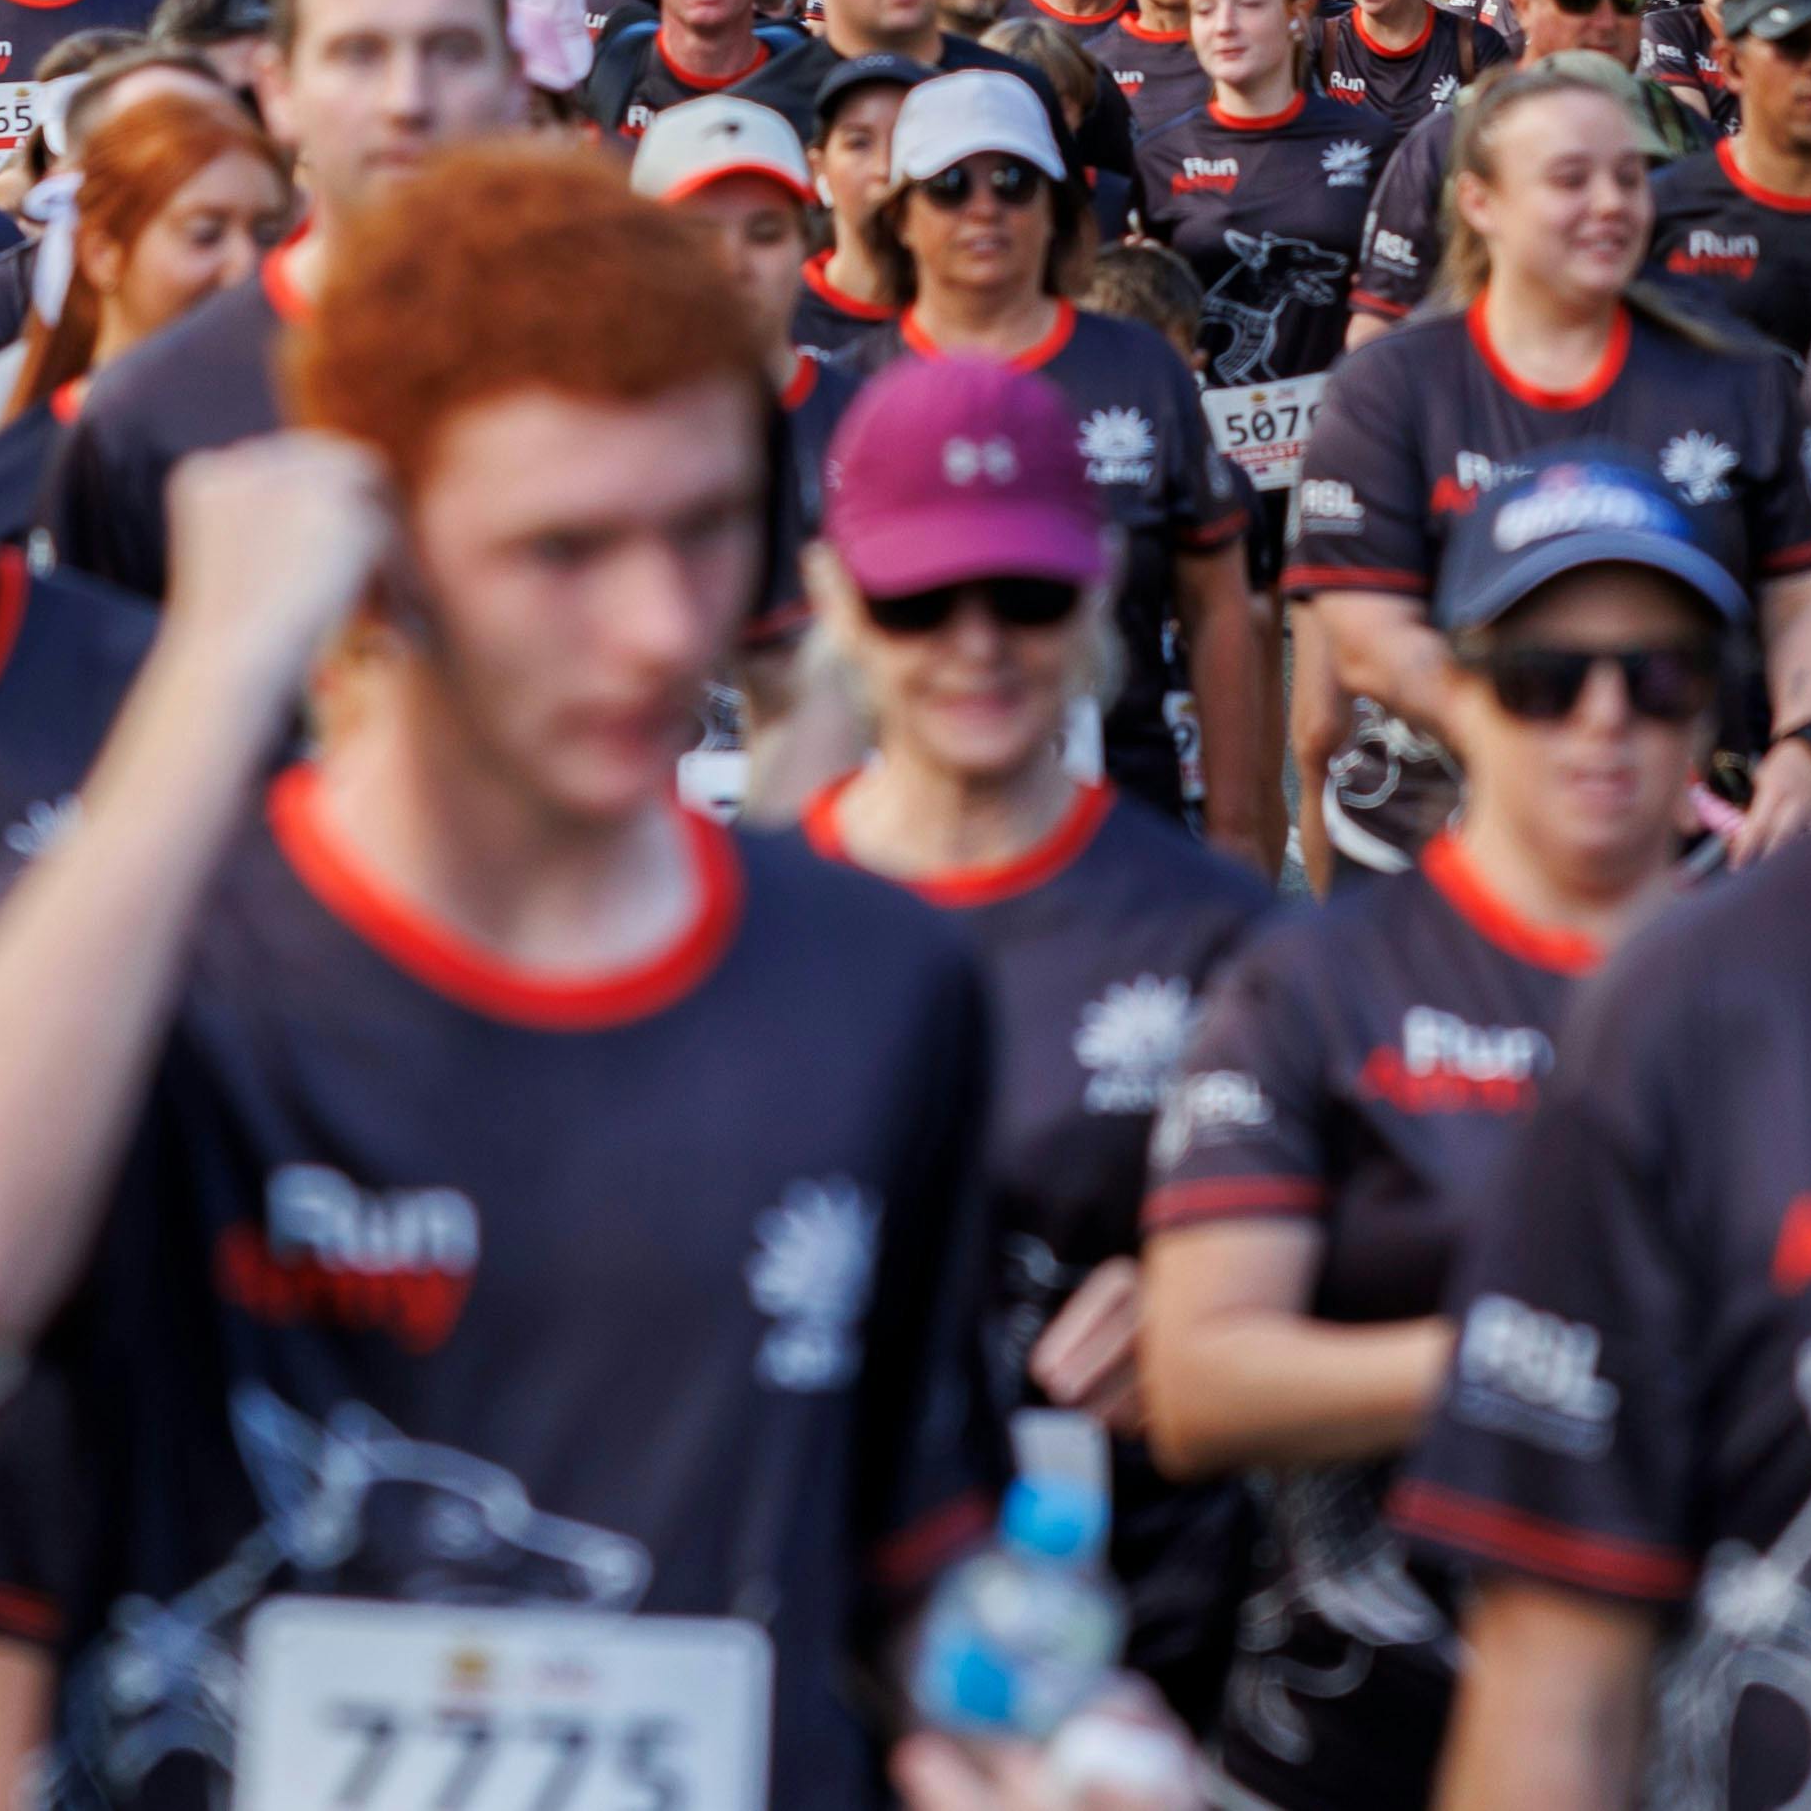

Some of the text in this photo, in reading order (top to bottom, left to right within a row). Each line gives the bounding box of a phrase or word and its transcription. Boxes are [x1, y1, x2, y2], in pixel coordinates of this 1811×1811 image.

[1113, 70, 1144, 85] un
[1330, 70, 1365, 92] Run
[1182, 157, 1239, 180] Run
[1689, 230, 1759, 258] Run
